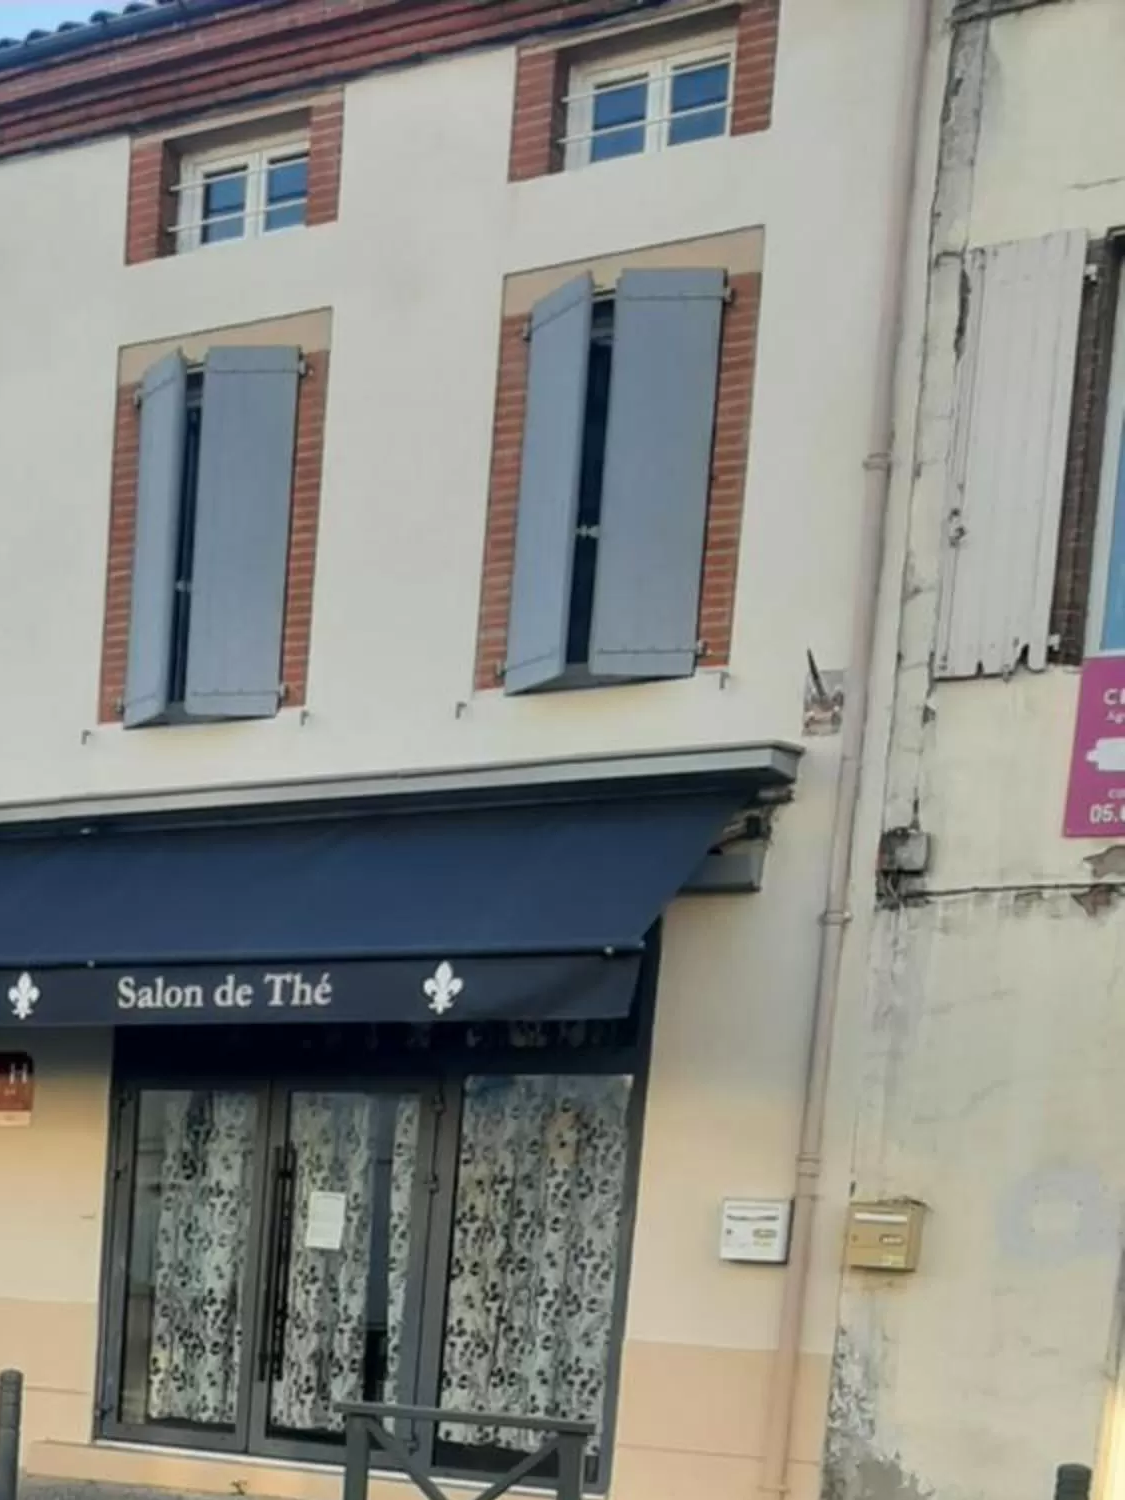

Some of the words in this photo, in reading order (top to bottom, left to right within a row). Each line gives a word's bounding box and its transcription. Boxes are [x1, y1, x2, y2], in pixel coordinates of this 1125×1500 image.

[117, 976, 203, 1009] Salon
[213, 974, 253, 1006] de
[263, 972, 332, 1006] Thé
